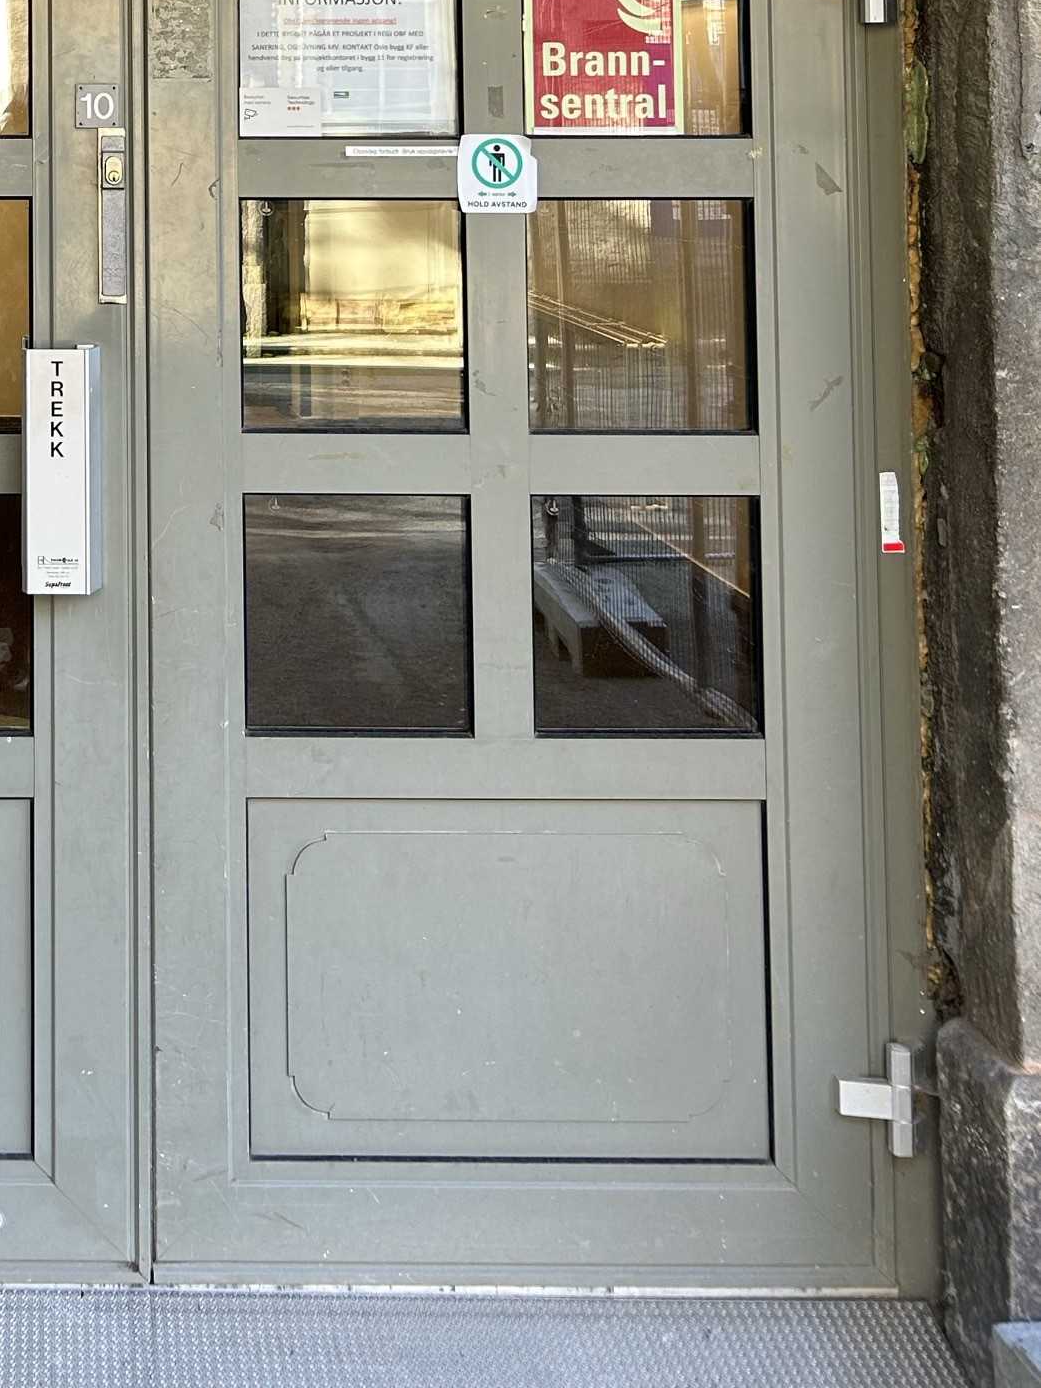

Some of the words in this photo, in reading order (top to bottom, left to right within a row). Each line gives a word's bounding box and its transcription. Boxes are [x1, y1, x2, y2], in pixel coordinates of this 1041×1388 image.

[542, 42, 665, 77] Brann-
[80, 92, 115, 120] 10
[540, 84, 667, 120] sentral
[50, 361, 64, 458] TREKK
